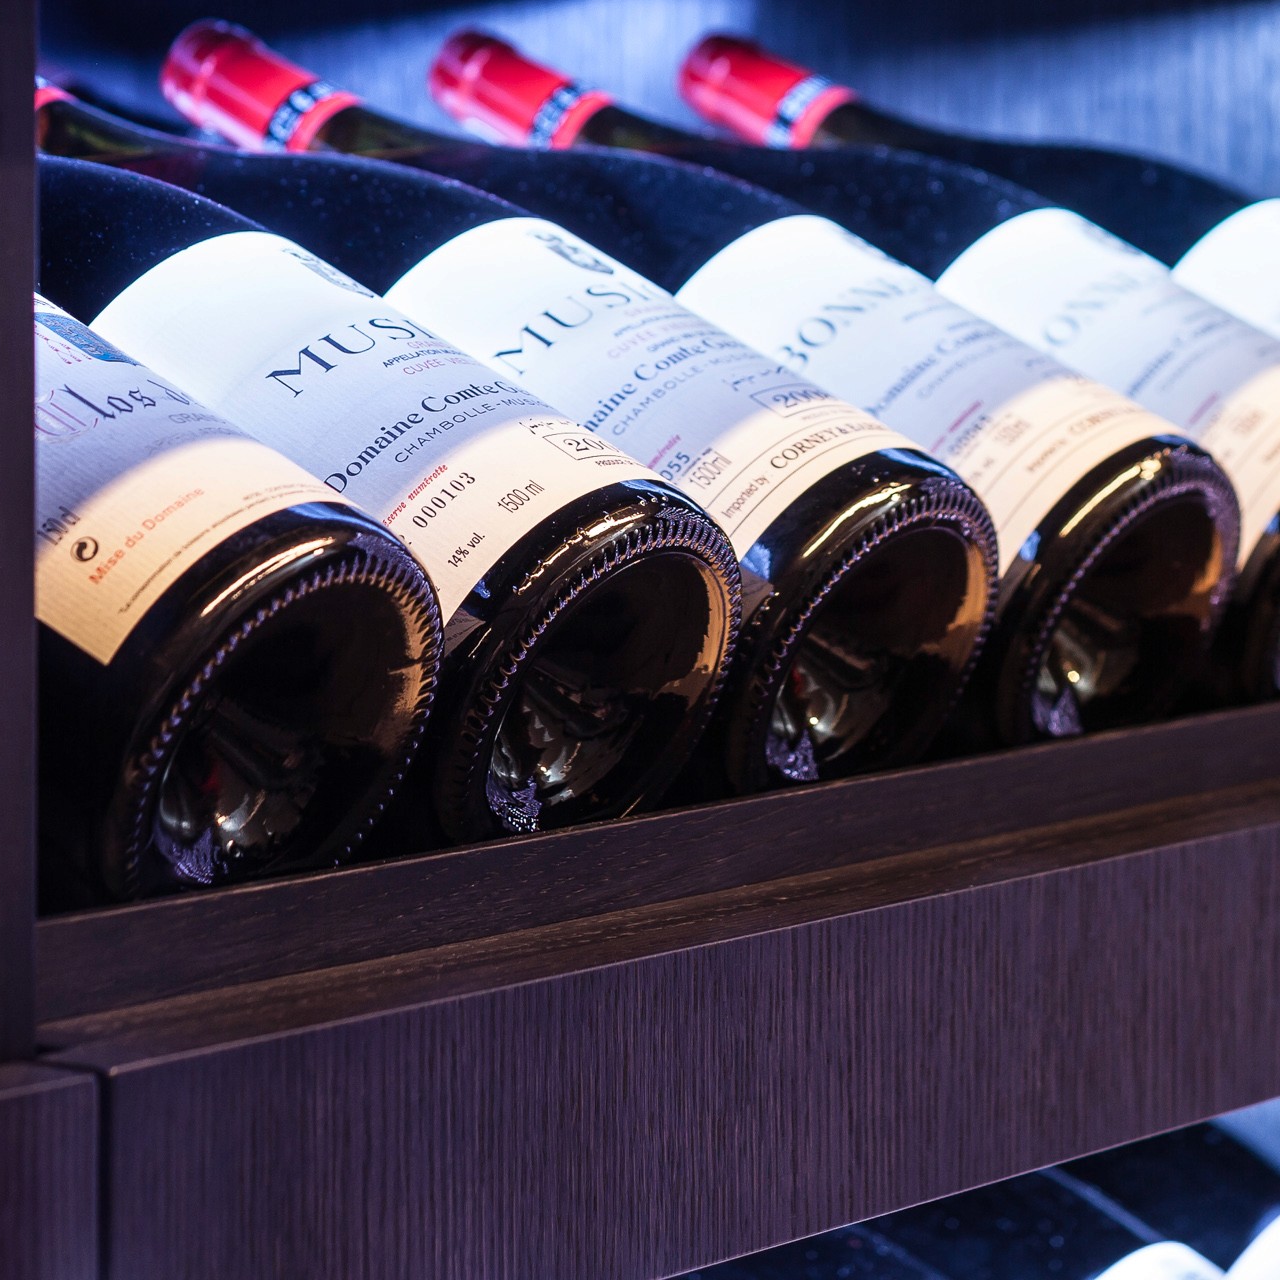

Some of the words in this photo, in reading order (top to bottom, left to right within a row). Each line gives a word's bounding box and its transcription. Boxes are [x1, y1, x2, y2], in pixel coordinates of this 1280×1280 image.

[633, 338, 705, 382] Comte
[323, 412, 424, 494] Domaine
[421, 381, 500, 412] Comte
[411, 471, 477, 529] 000103
[496, 488, 531, 514] 1500
[721, 480, 759, 519] Imported
[770, 426, 841, 470] CORNEY
[88, 548, 126, 585] Mise
[124, 532, 145, 549] du
[141, 487, 205, 531] Domaine
[447, 546, 472, 568] 14%
[467, 532, 487, 551] vol.
